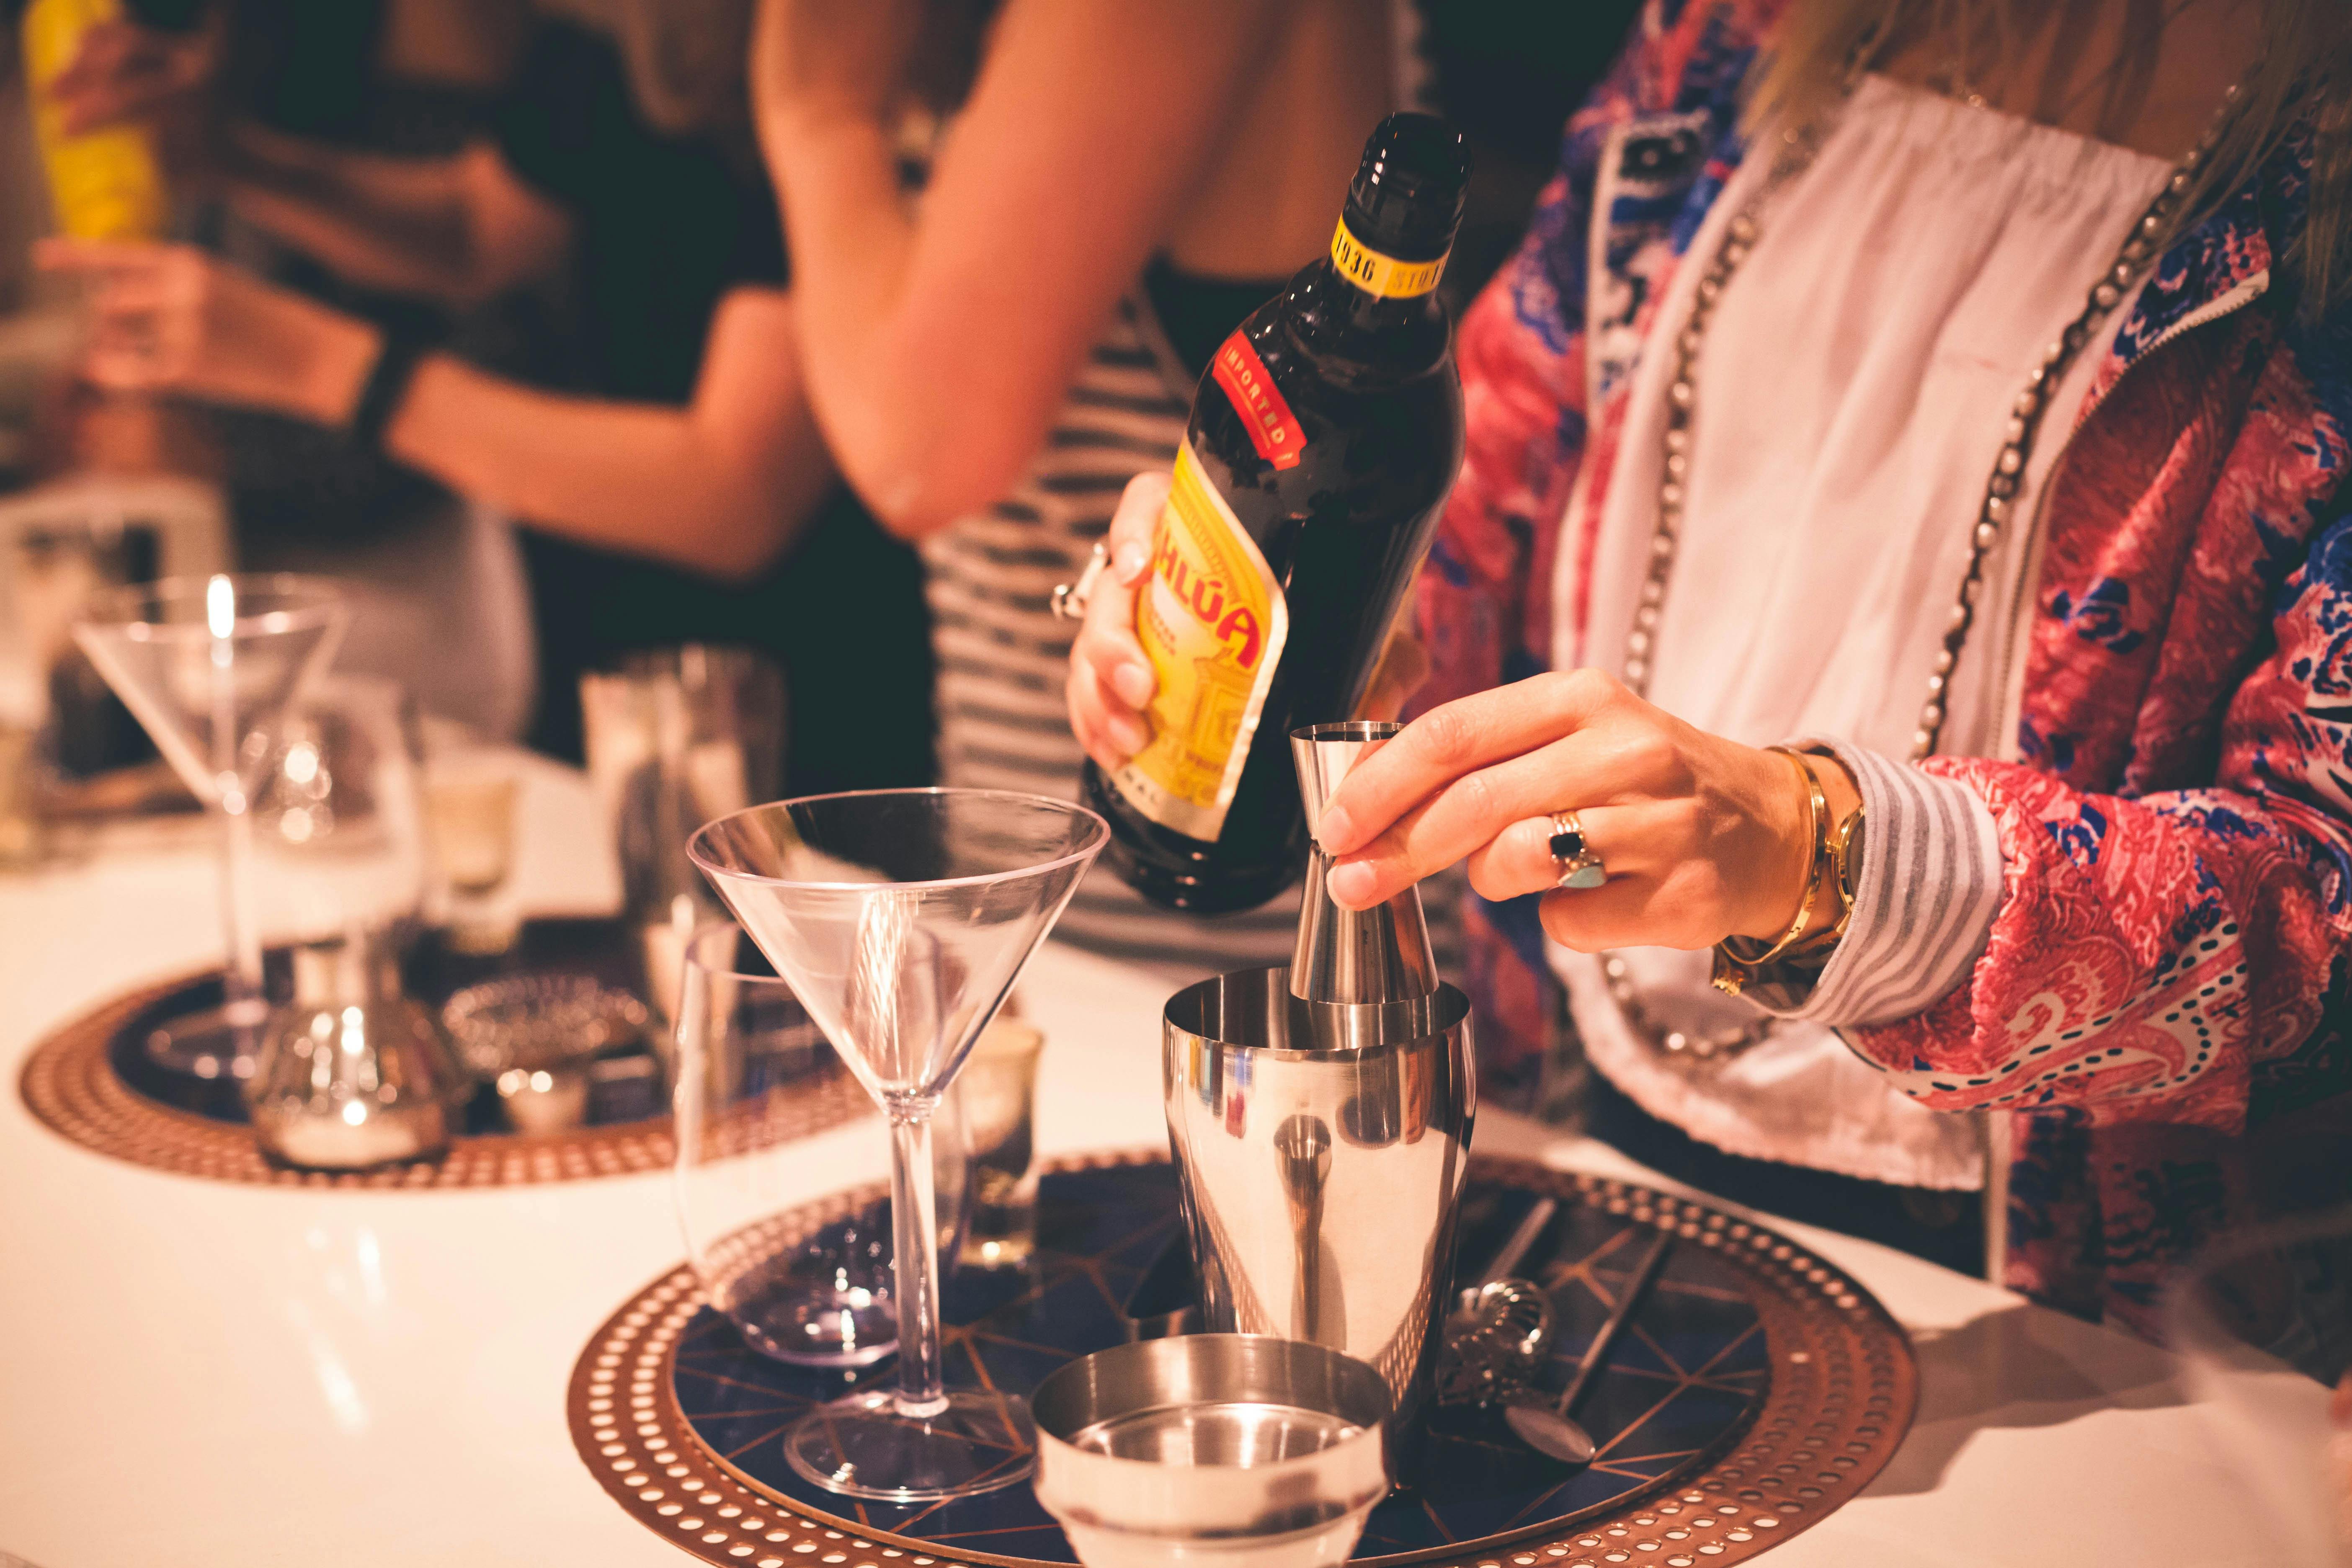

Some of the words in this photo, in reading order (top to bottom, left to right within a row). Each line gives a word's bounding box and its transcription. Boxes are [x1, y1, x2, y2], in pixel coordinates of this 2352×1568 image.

[1336, 233, 1375, 283] 1936
[1224, 345, 1285, 444] IMPORTED
[1157, 527, 1260, 669] HLÚA
